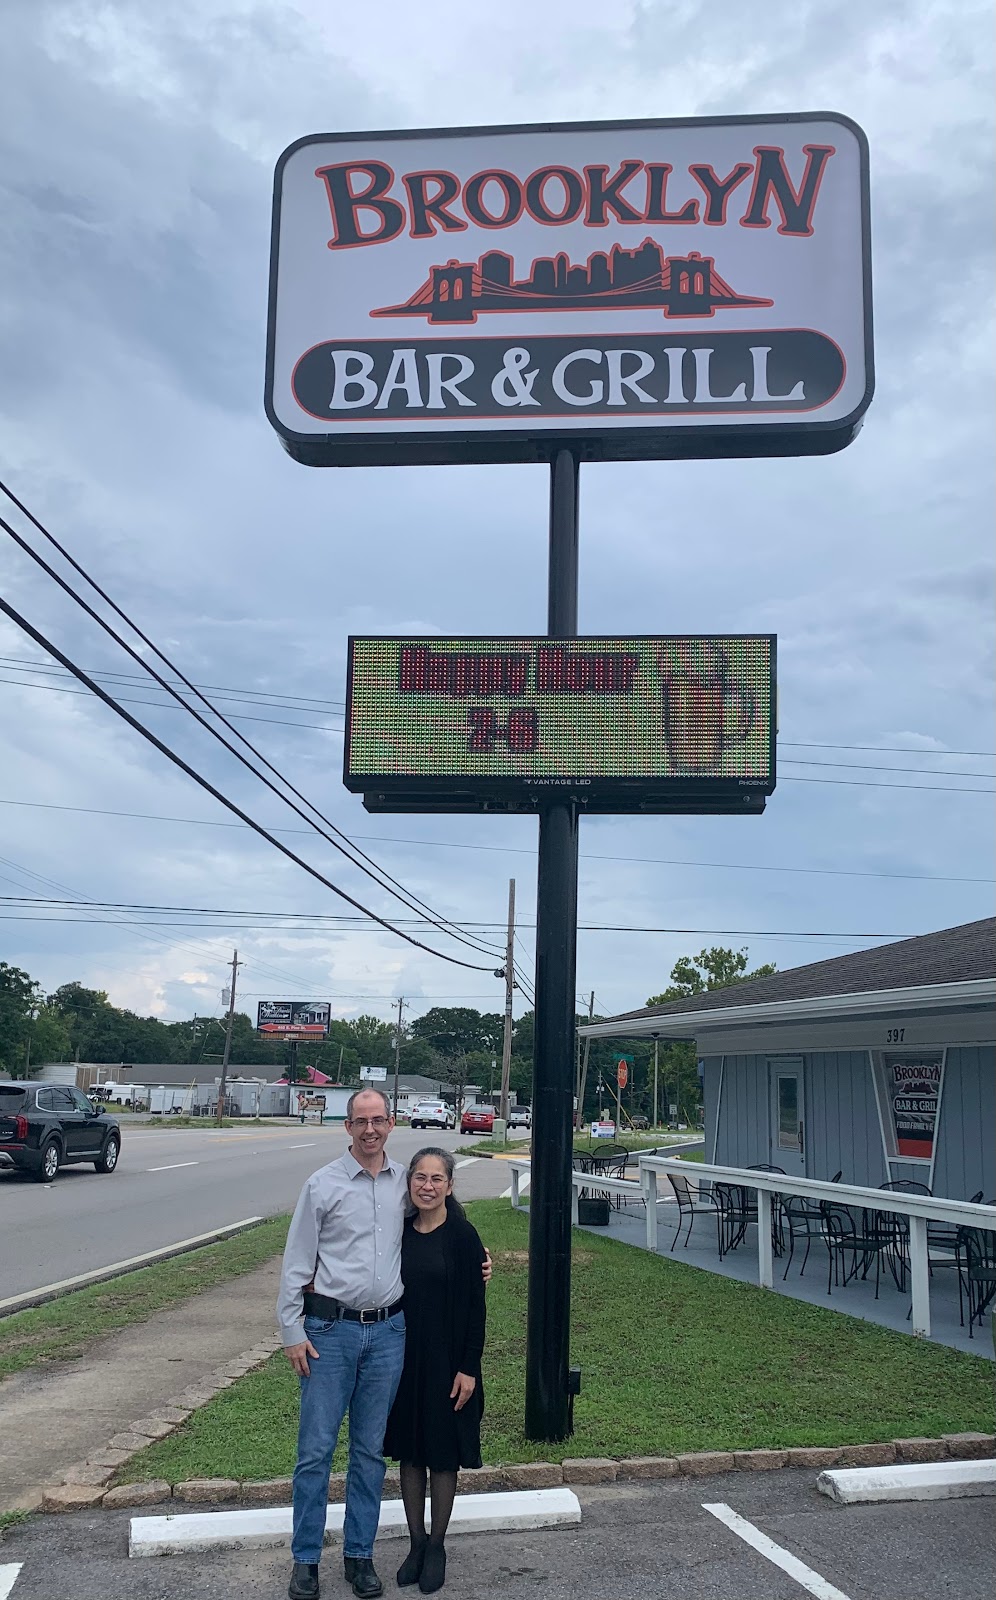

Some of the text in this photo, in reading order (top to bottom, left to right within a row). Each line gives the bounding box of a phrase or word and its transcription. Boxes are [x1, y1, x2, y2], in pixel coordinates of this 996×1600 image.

[316, 145, 836, 249] BROOKLYN
[330, 347, 805, 410] BAR & GRILL
[401, 647, 635, 694] Happy Hour
[471, 710, 536, 749] 2-6
[887, 1028, 905, 1043] 397
[618, 1069, 627, 1079] STOP
[896, 1100, 911, 1111] BAR
[912, 1101, 918, 1111] &
